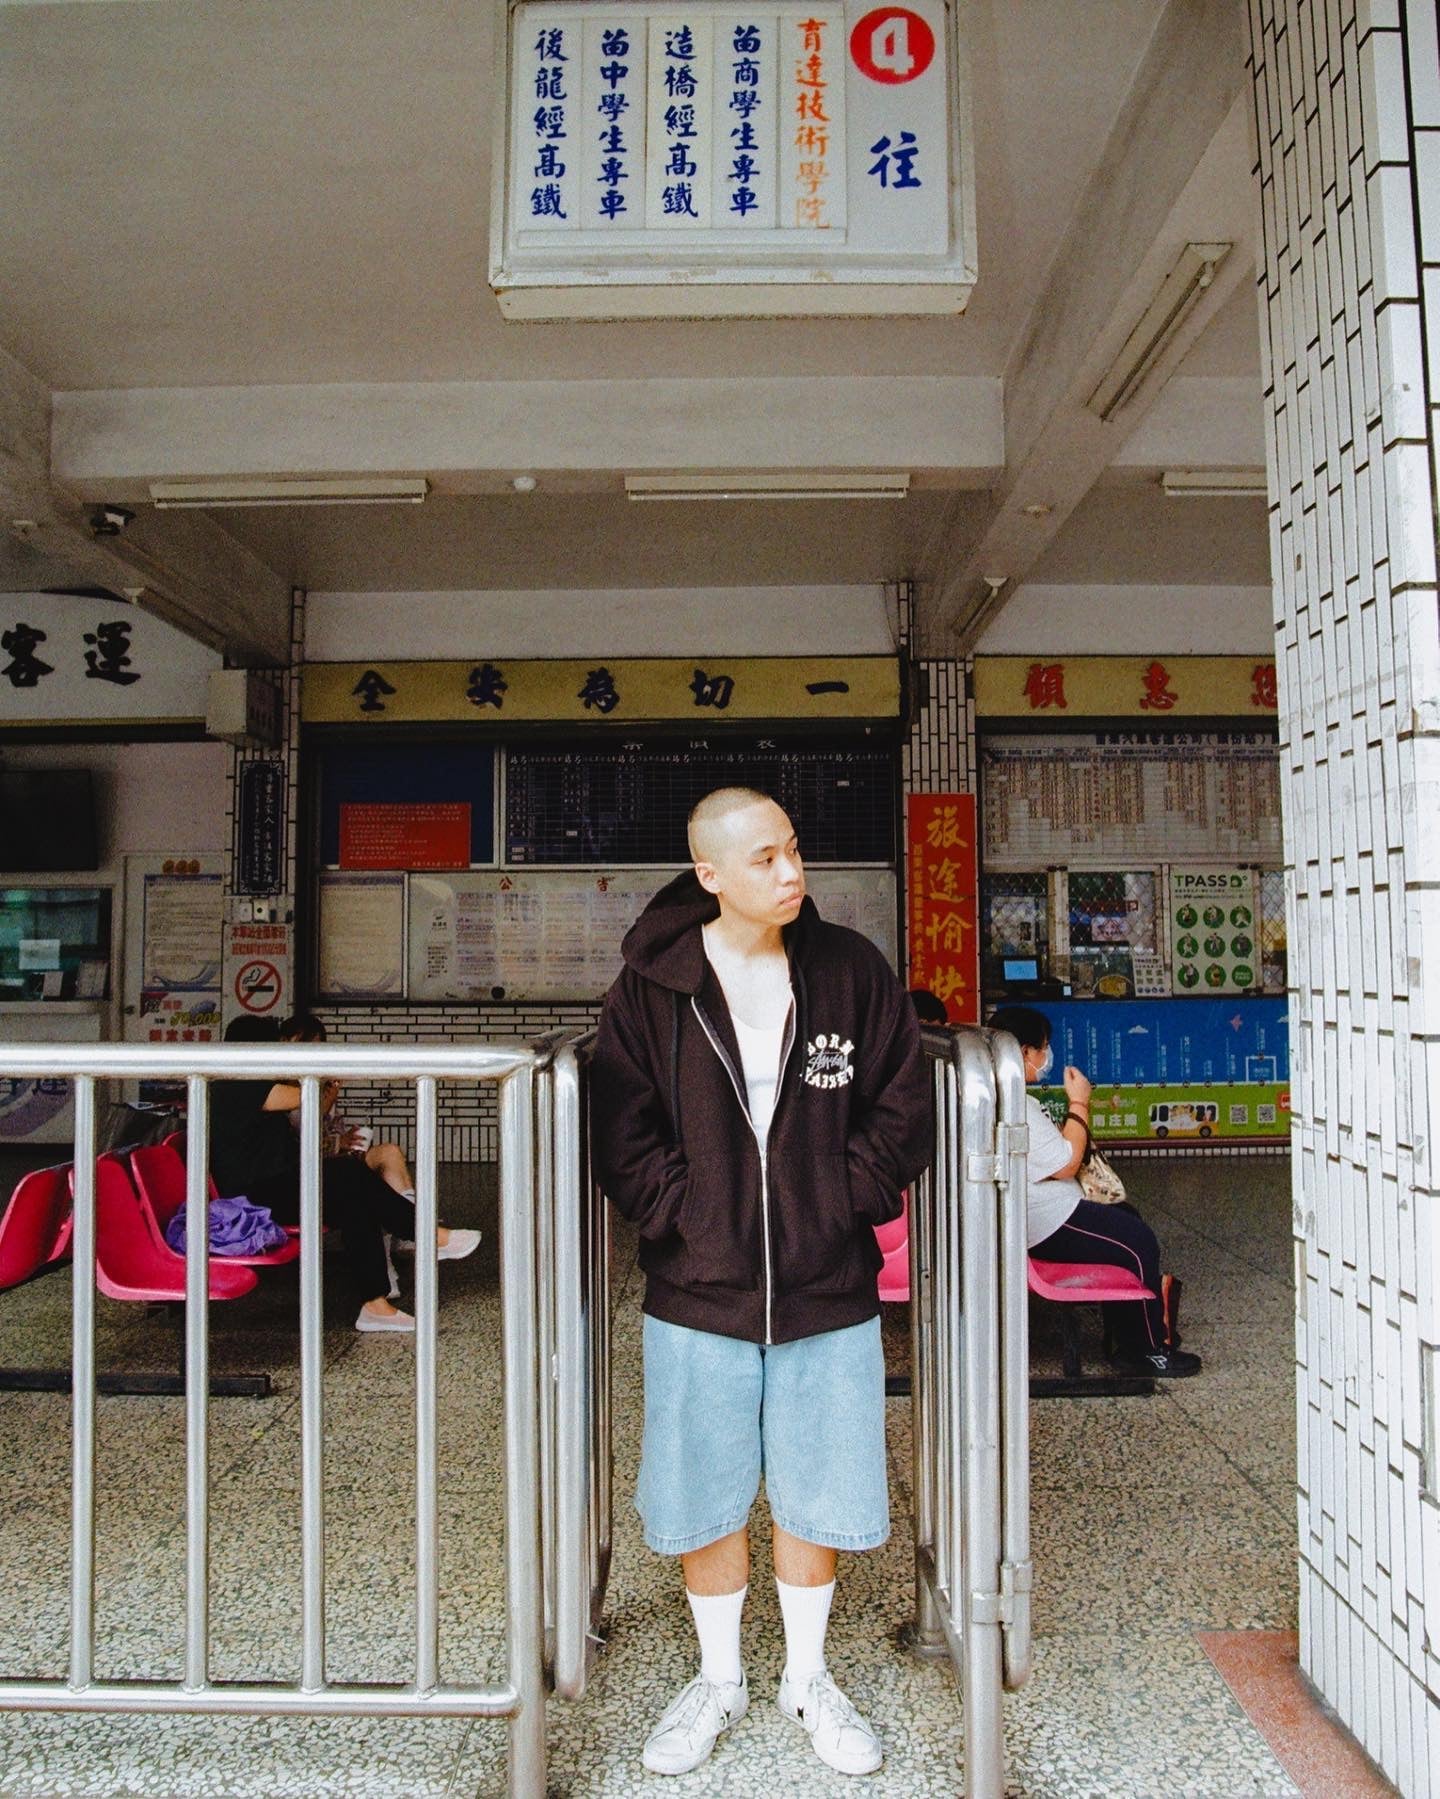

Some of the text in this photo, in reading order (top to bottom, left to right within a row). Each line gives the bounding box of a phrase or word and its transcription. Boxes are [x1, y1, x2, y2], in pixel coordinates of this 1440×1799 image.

[530, 27, 569, 220] 後龍經高鐵
[597, 28, 630, 221] 苗中學生專車
[662, 25, 699, 219] 造橋經高鐵
[728, 25, 762, 217] 苗商學生專車
[795, 17, 831, 230] 育達技術學院
[869, 16, 915, 77] 4
[867, 131, 922, 190] 往
[926, 805, 971, 1006] 旅途愉快
[1174, 874, 1228, 888] TPASS
